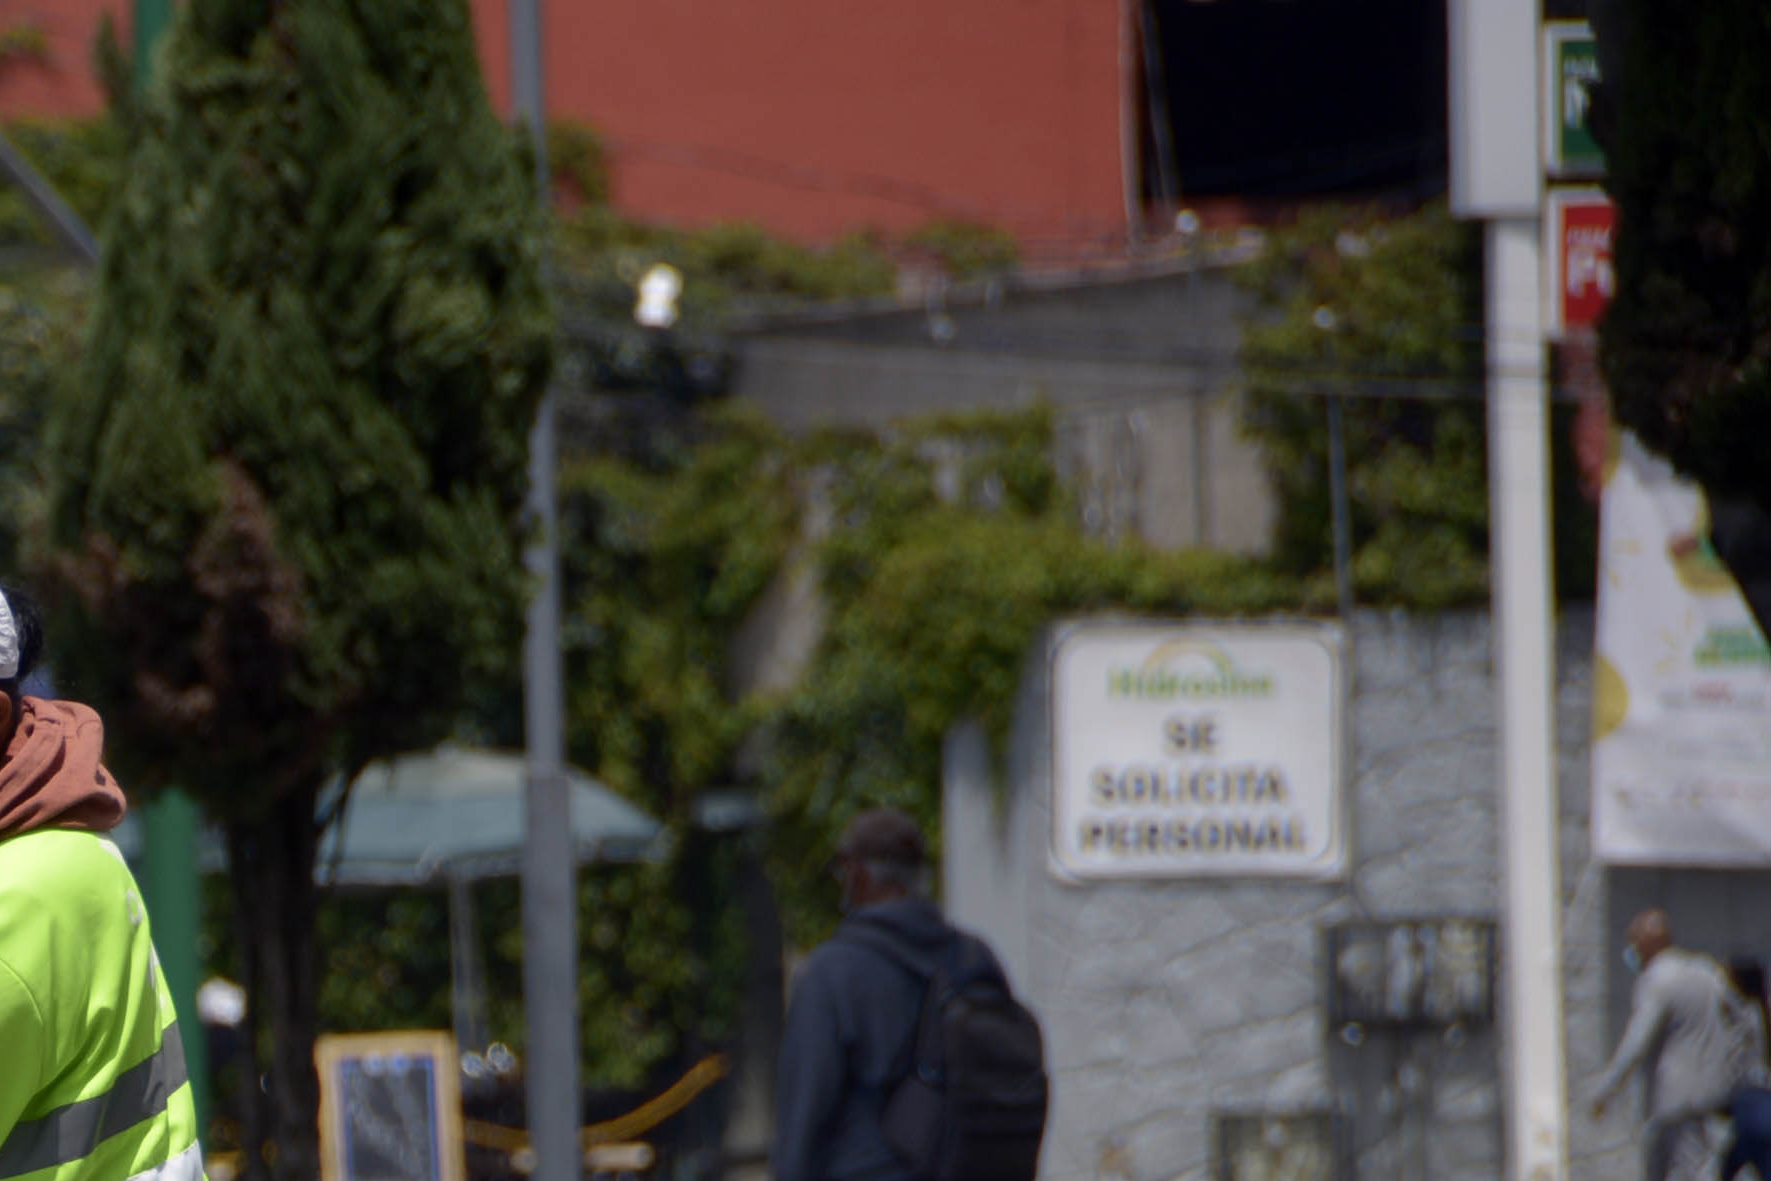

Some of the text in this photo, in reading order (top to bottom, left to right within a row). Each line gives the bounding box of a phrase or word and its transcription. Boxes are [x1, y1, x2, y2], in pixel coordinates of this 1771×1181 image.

[1164, 716, 1220, 752] SE
[1090, 765, 1289, 804] SOLICITA
[1080, 814, 1306, 853] PERSONAL
